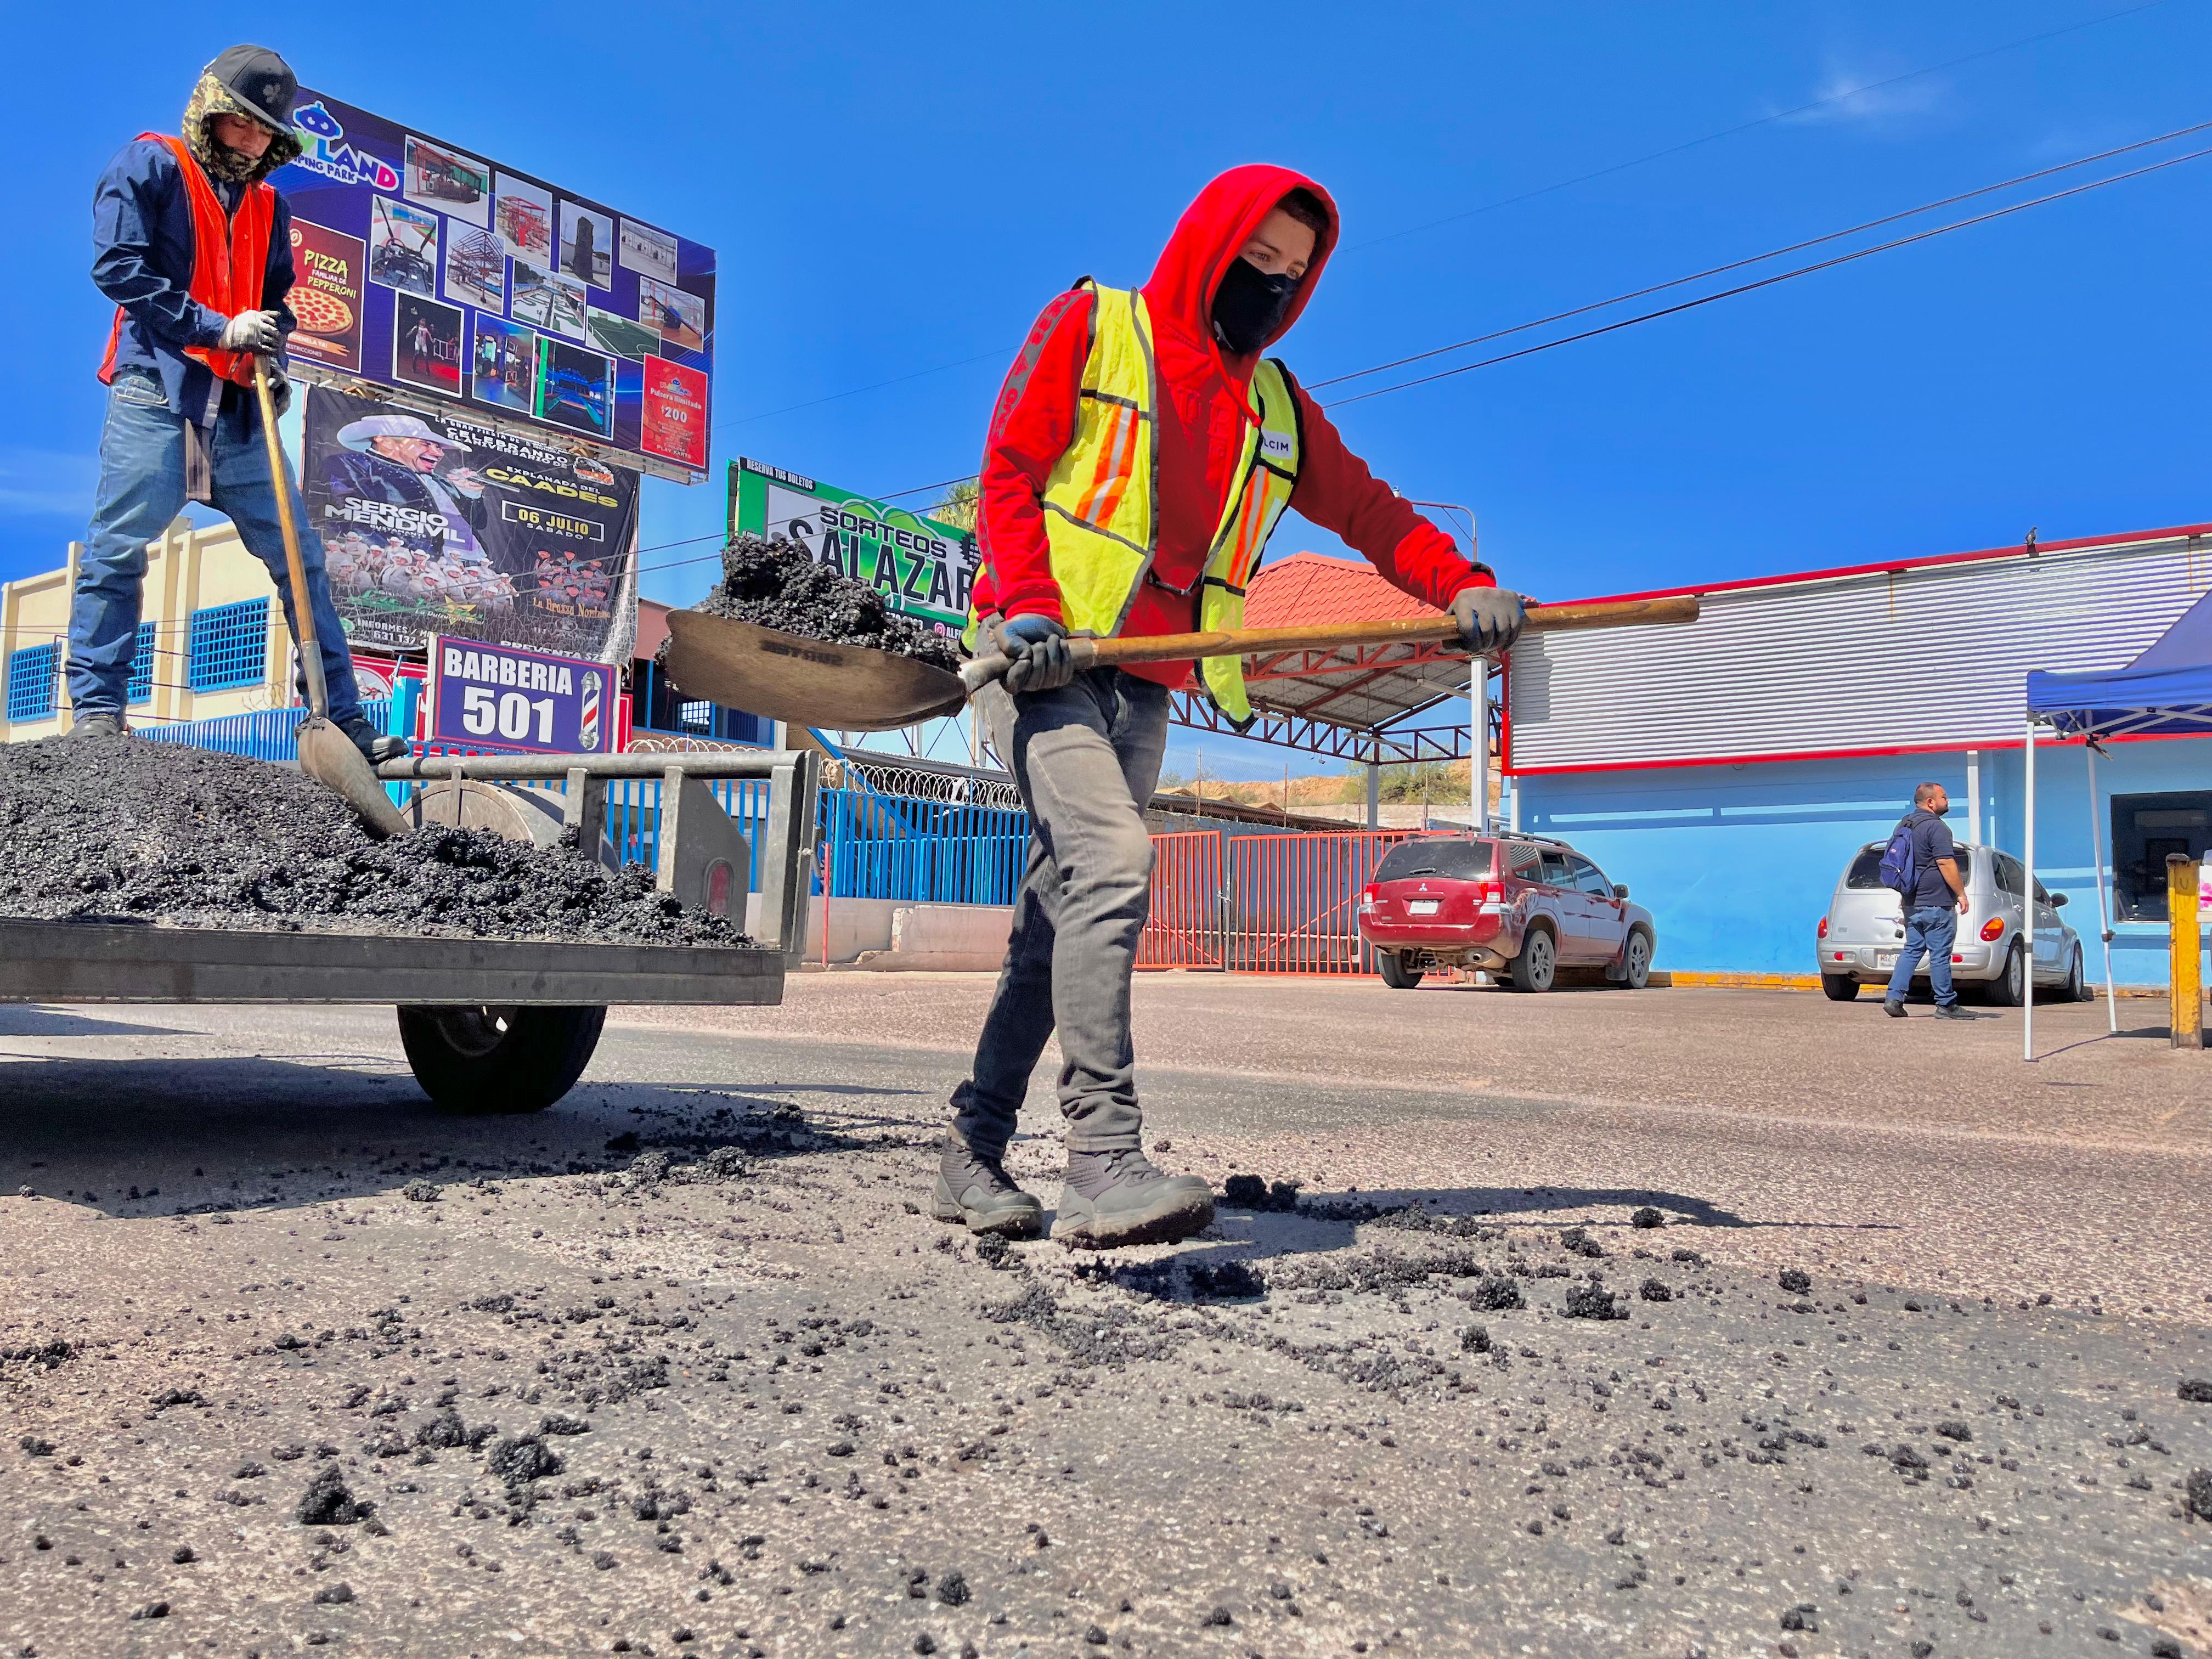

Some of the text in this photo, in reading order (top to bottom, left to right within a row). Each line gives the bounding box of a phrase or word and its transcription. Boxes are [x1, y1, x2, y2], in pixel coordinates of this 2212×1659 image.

[328, 165, 356, 181] PARK
[304, 249, 348, 279] PIZZA
[312, 269, 338, 284] FAMILIAR
[307, 275, 357, 300] PEPPERONI
[650, 387, 674, 401] Pulsera
[661, 404, 687, 423] $200
[446, 427, 568, 464] CELEBRANDO
[447, 433, 461, 441] EL
[464, 438, 550, 464] ANIVERSARIO
[552, 460, 567, 469] DE
[657, 444, 672, 453] PLAY
[486, 468, 618, 508] CAADES
[506, 465, 578, 489] EXPLANADA
[580, 484, 601, 494] DEL
[746, 458, 814, 490] RESERVA TUS BOLETOS
[324, 504, 466, 543] MENDIVIL
[345, 496, 449, 527] SERGIO
[518, 509, 589, 535] 06 JULIO
[526, 522, 584, 540] SABADO
[820, 505, 947, 558] SORTEOS
[788, 519, 973, 611] SALAZAR
[357, 618, 408, 634] INFORMES
[374, 630, 396, 641] 631
[397, 634, 416, 645] 137
[500, 640, 582, 659] PREVENTA
[444, 647, 573, 696] BARBERIA
[462, 685, 555, 744] 501
